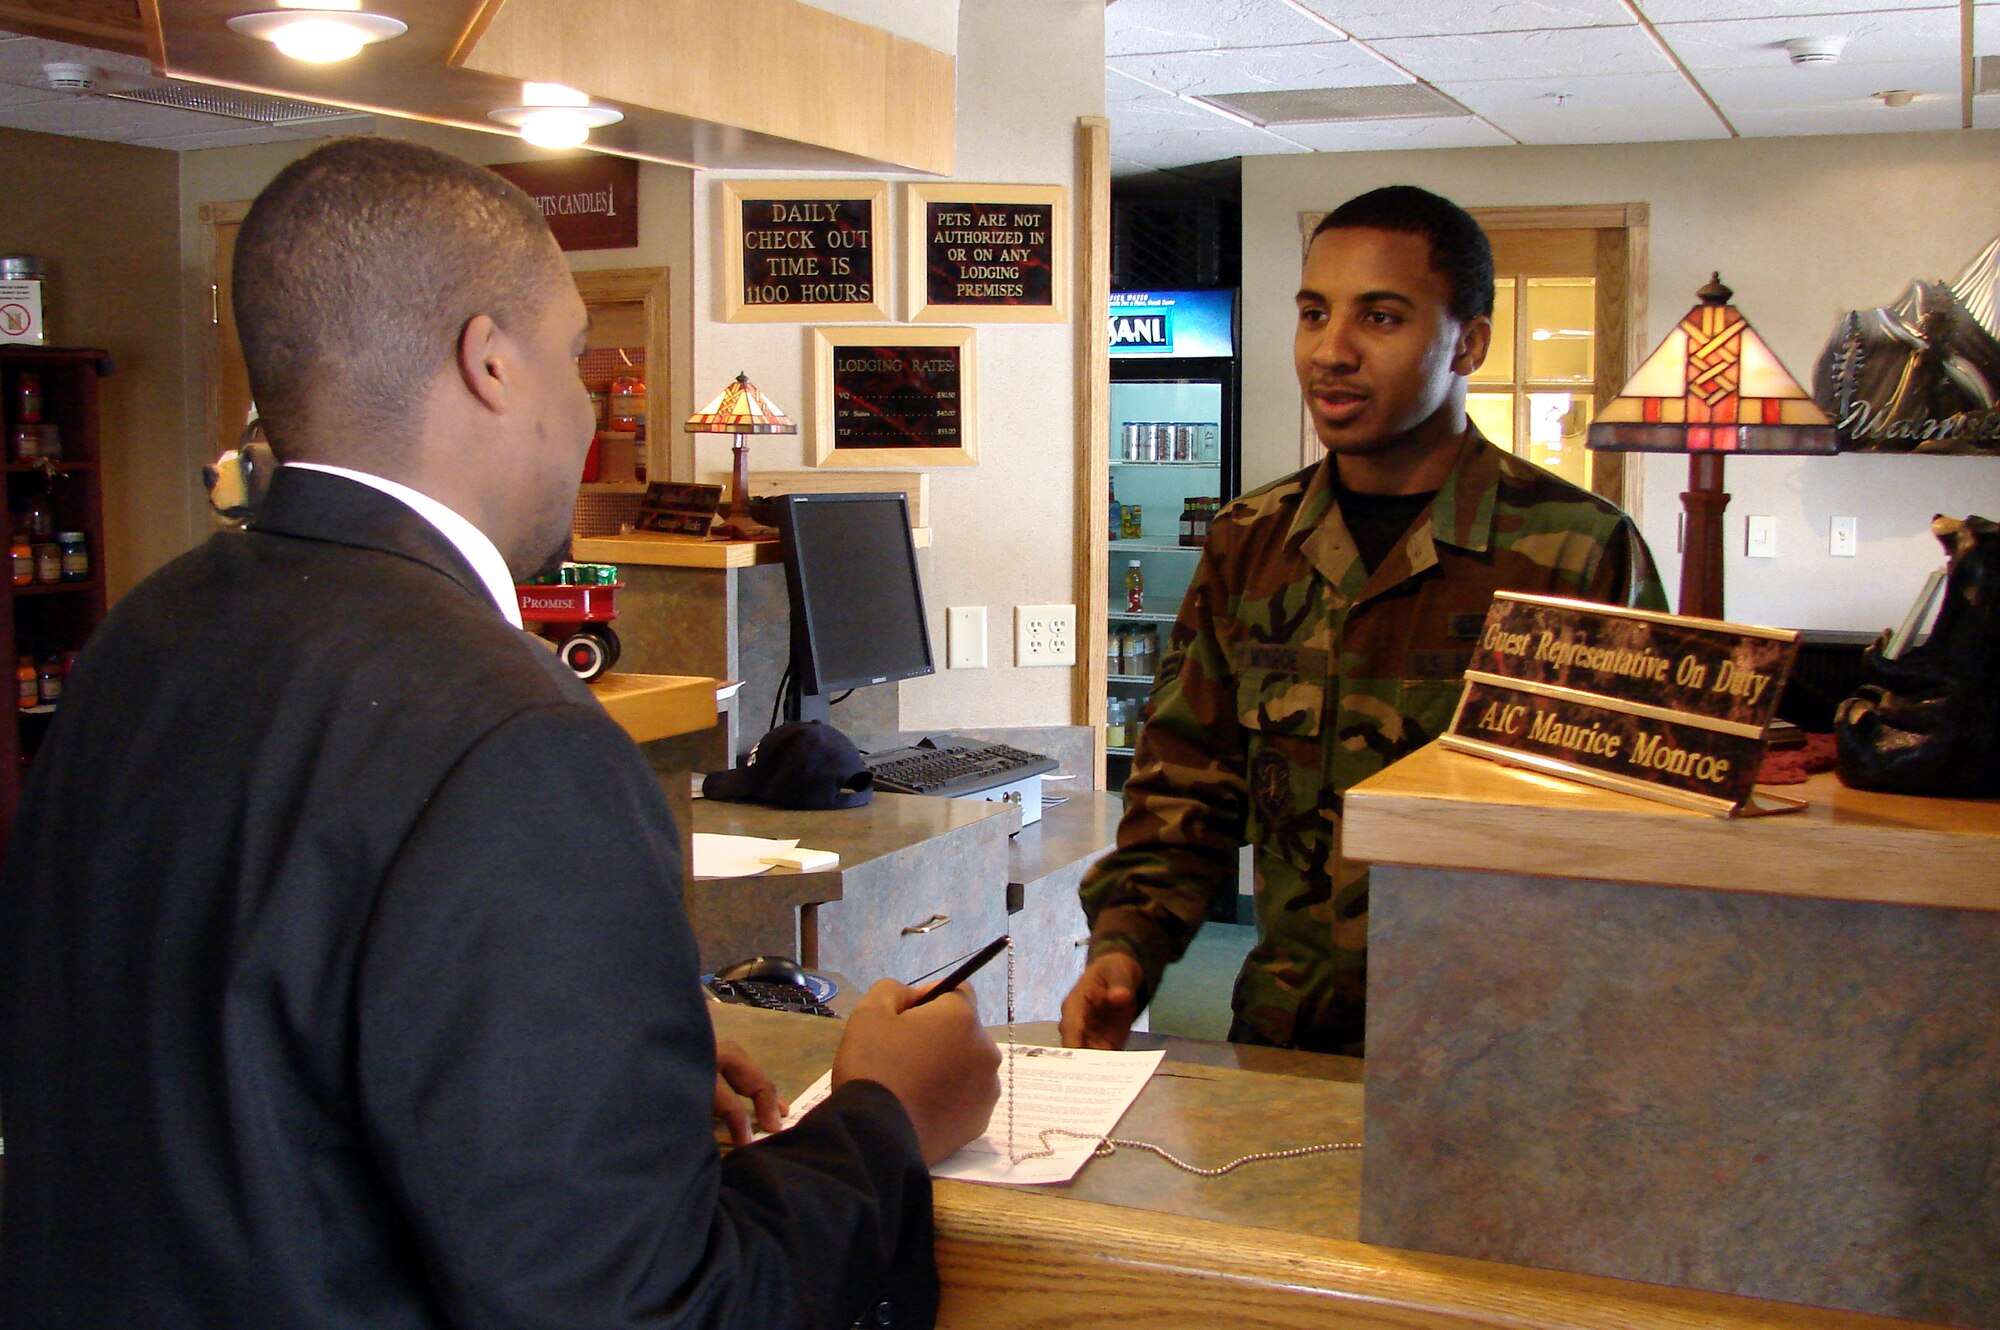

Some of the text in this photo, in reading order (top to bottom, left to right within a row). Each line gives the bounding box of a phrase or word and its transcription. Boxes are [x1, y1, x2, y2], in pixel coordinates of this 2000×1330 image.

[558, 192, 608, 215] CANDLES
[772, 203, 842, 223] DAILY
[937, 213, 1042, 227] PETS ARE NOT
[745, 229, 870, 250] CHECK OUT
[934, 231, 1045, 245] AUTHORIZED IN
[947, 248, 1031, 262] OR ON ANY
[766, 257, 851, 277] TIME IS
[960, 266, 1020, 280] LODGING
[746, 283, 871, 304] 1100 HOURS
[956, 283, 1024, 298] PREMISES
[839, 360, 955, 372] LODGING RATES:
[522, 596, 576, 609] PROMISE
[1483, 622, 1770, 706] Guest Representative On Duty
[1529, 710, 1622, 758] Maurice
[1628, 731, 1731, 784] Monroe
